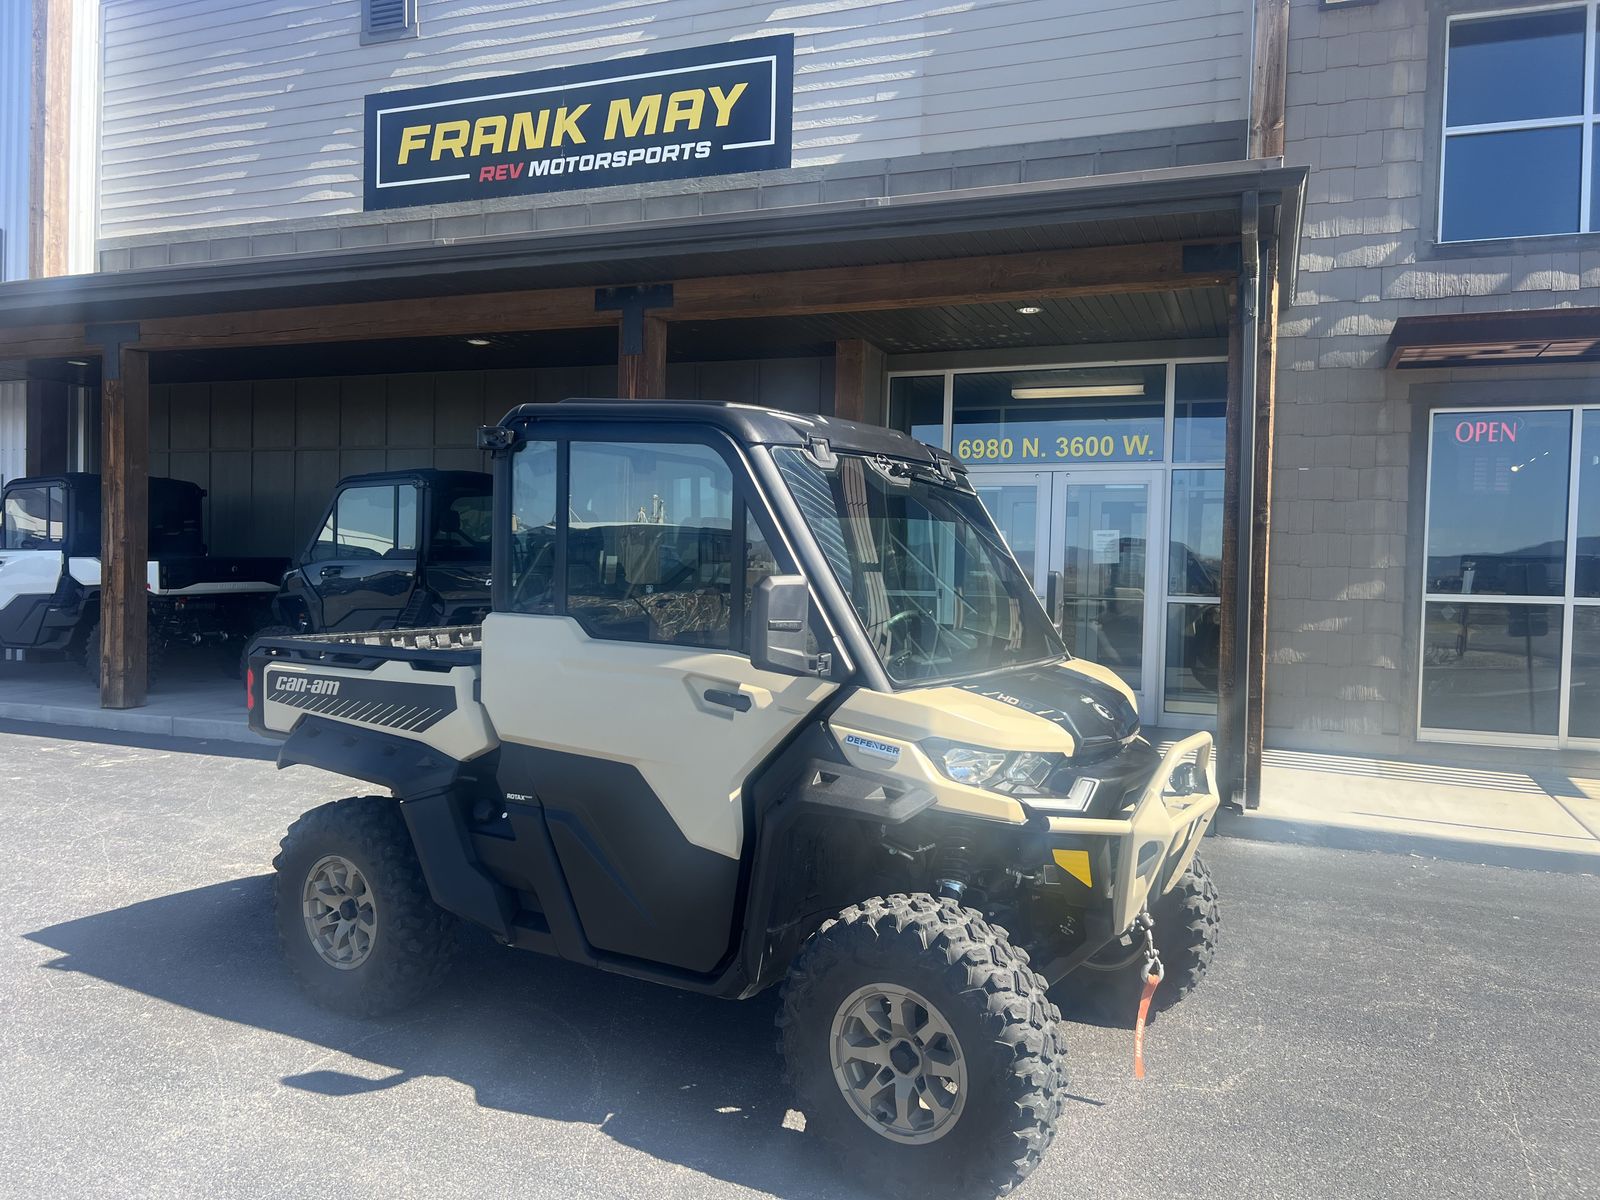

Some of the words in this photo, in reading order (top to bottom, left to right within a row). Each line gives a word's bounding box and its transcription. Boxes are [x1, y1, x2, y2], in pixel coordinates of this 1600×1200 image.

[398, 104, 591, 165] FRANK
[604, 83, 748, 140] MAY
[479, 162, 524, 183] REV
[528, 141, 712, 177] MOTORSPORTS
[1455, 421, 1517, 443] OPEN
[958, 438, 1014, 459] 6980
[1022, 437, 1046, 458] N.
[1055, 436, 1114, 457] 3600
[1122, 434, 1154, 456] W.
[275, 676, 340, 696] can-am
[847, 735, 900, 755] DEFENDER
